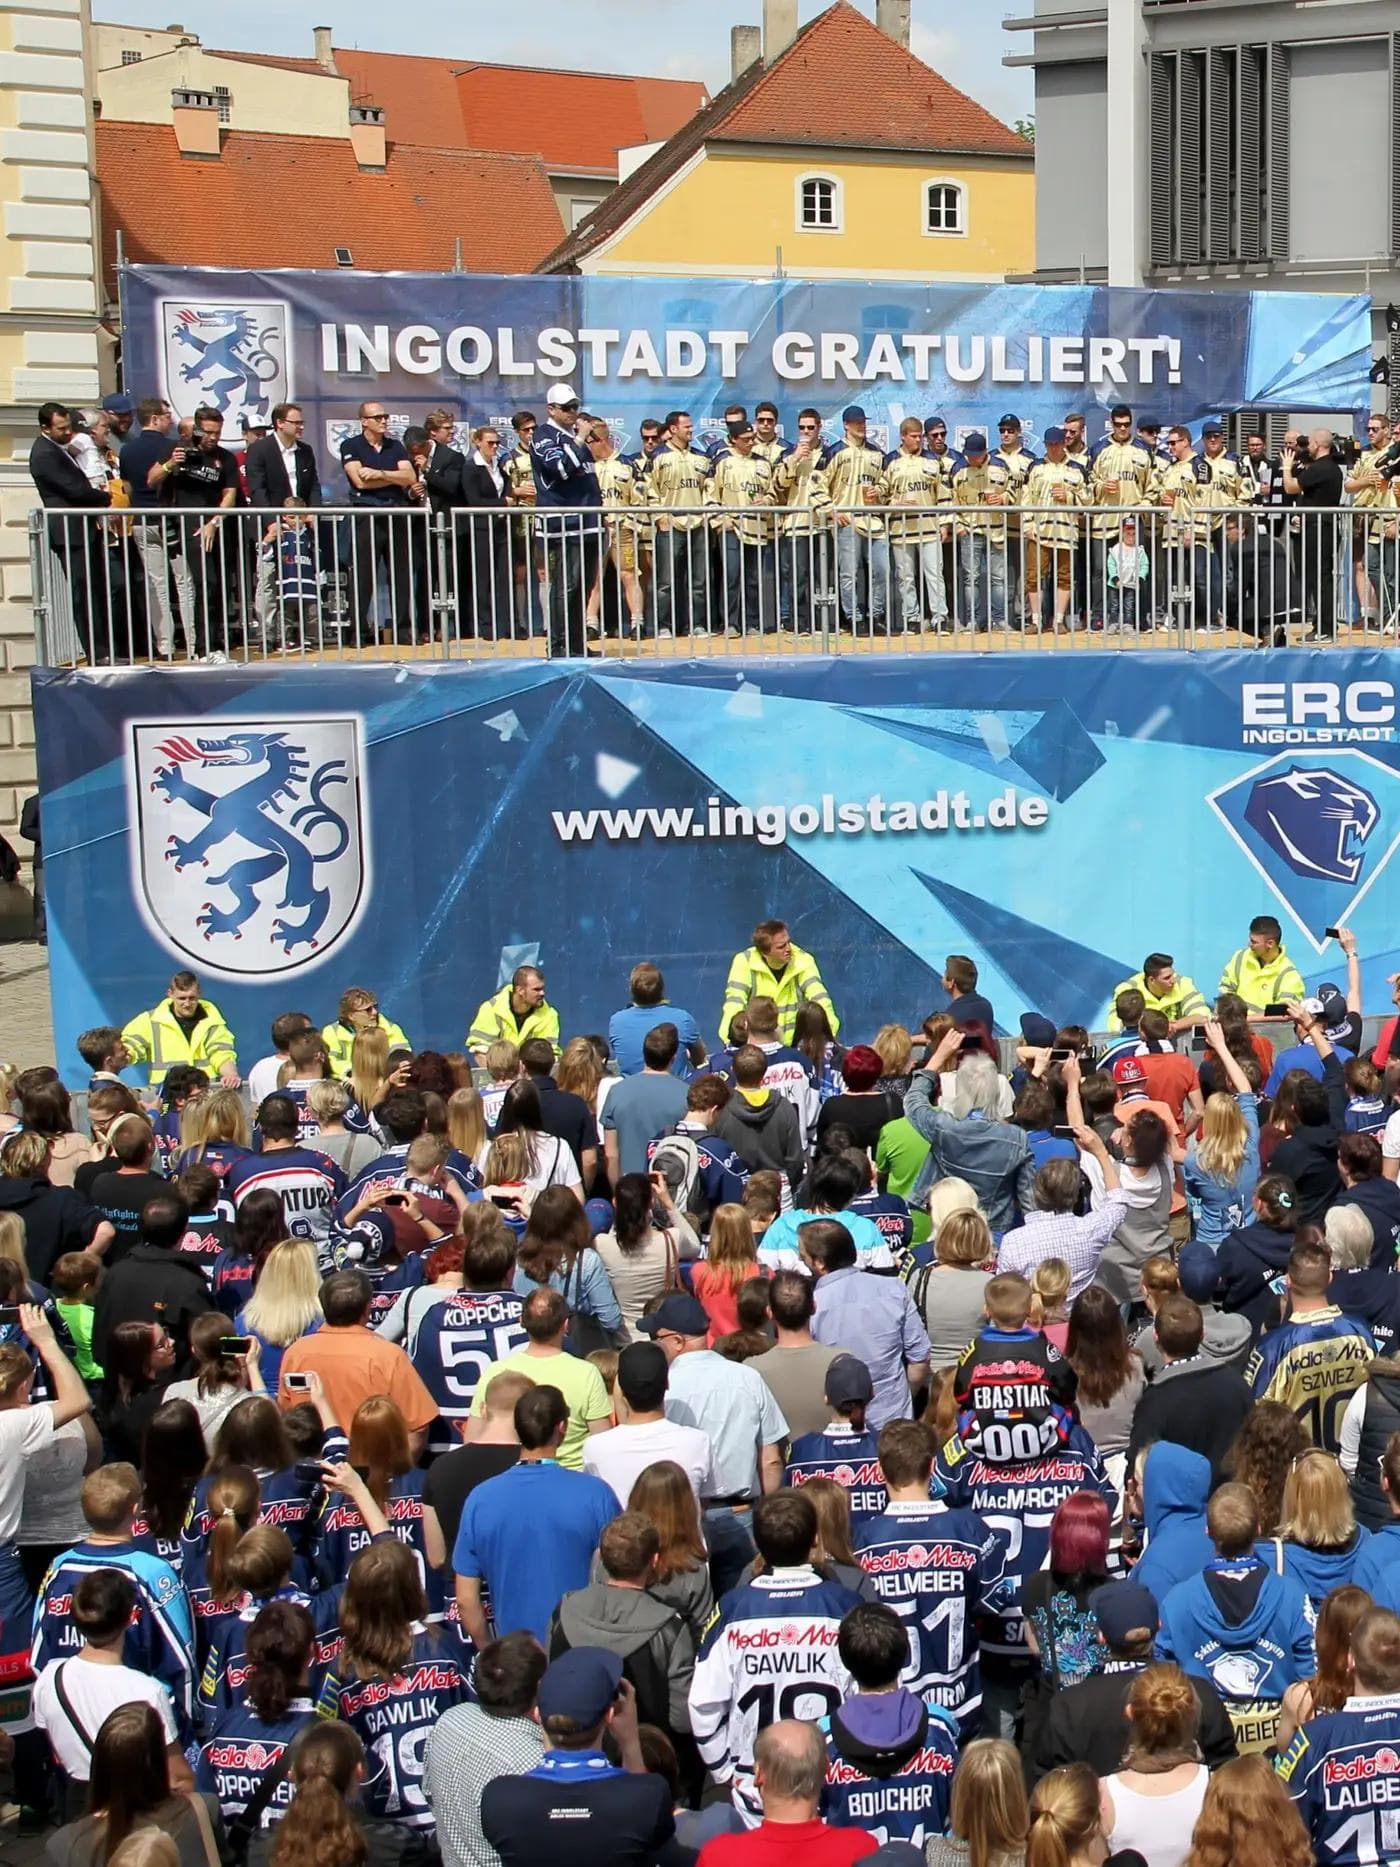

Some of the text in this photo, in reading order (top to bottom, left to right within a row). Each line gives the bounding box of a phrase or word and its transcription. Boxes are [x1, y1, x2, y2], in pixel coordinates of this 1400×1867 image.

[321, 323, 1182, 384] INGOLSTADT GRATULIERT!
[387, 414, 410, 423] RC
[1242, 682, 1395, 725] ERC
[1242, 726, 1395, 743] INGOLSTADT
[551, 788, 1050, 847] www.ingolstadt.de
[1371, 1324, 1394, 1338] hite
[769, 1590, 804, 1599] BAUER
[727, 1627, 780, 1649] Media
[744, 1650, 828, 1675] GAWLIK
[847, 1784, 933, 1817] BOUCHER
